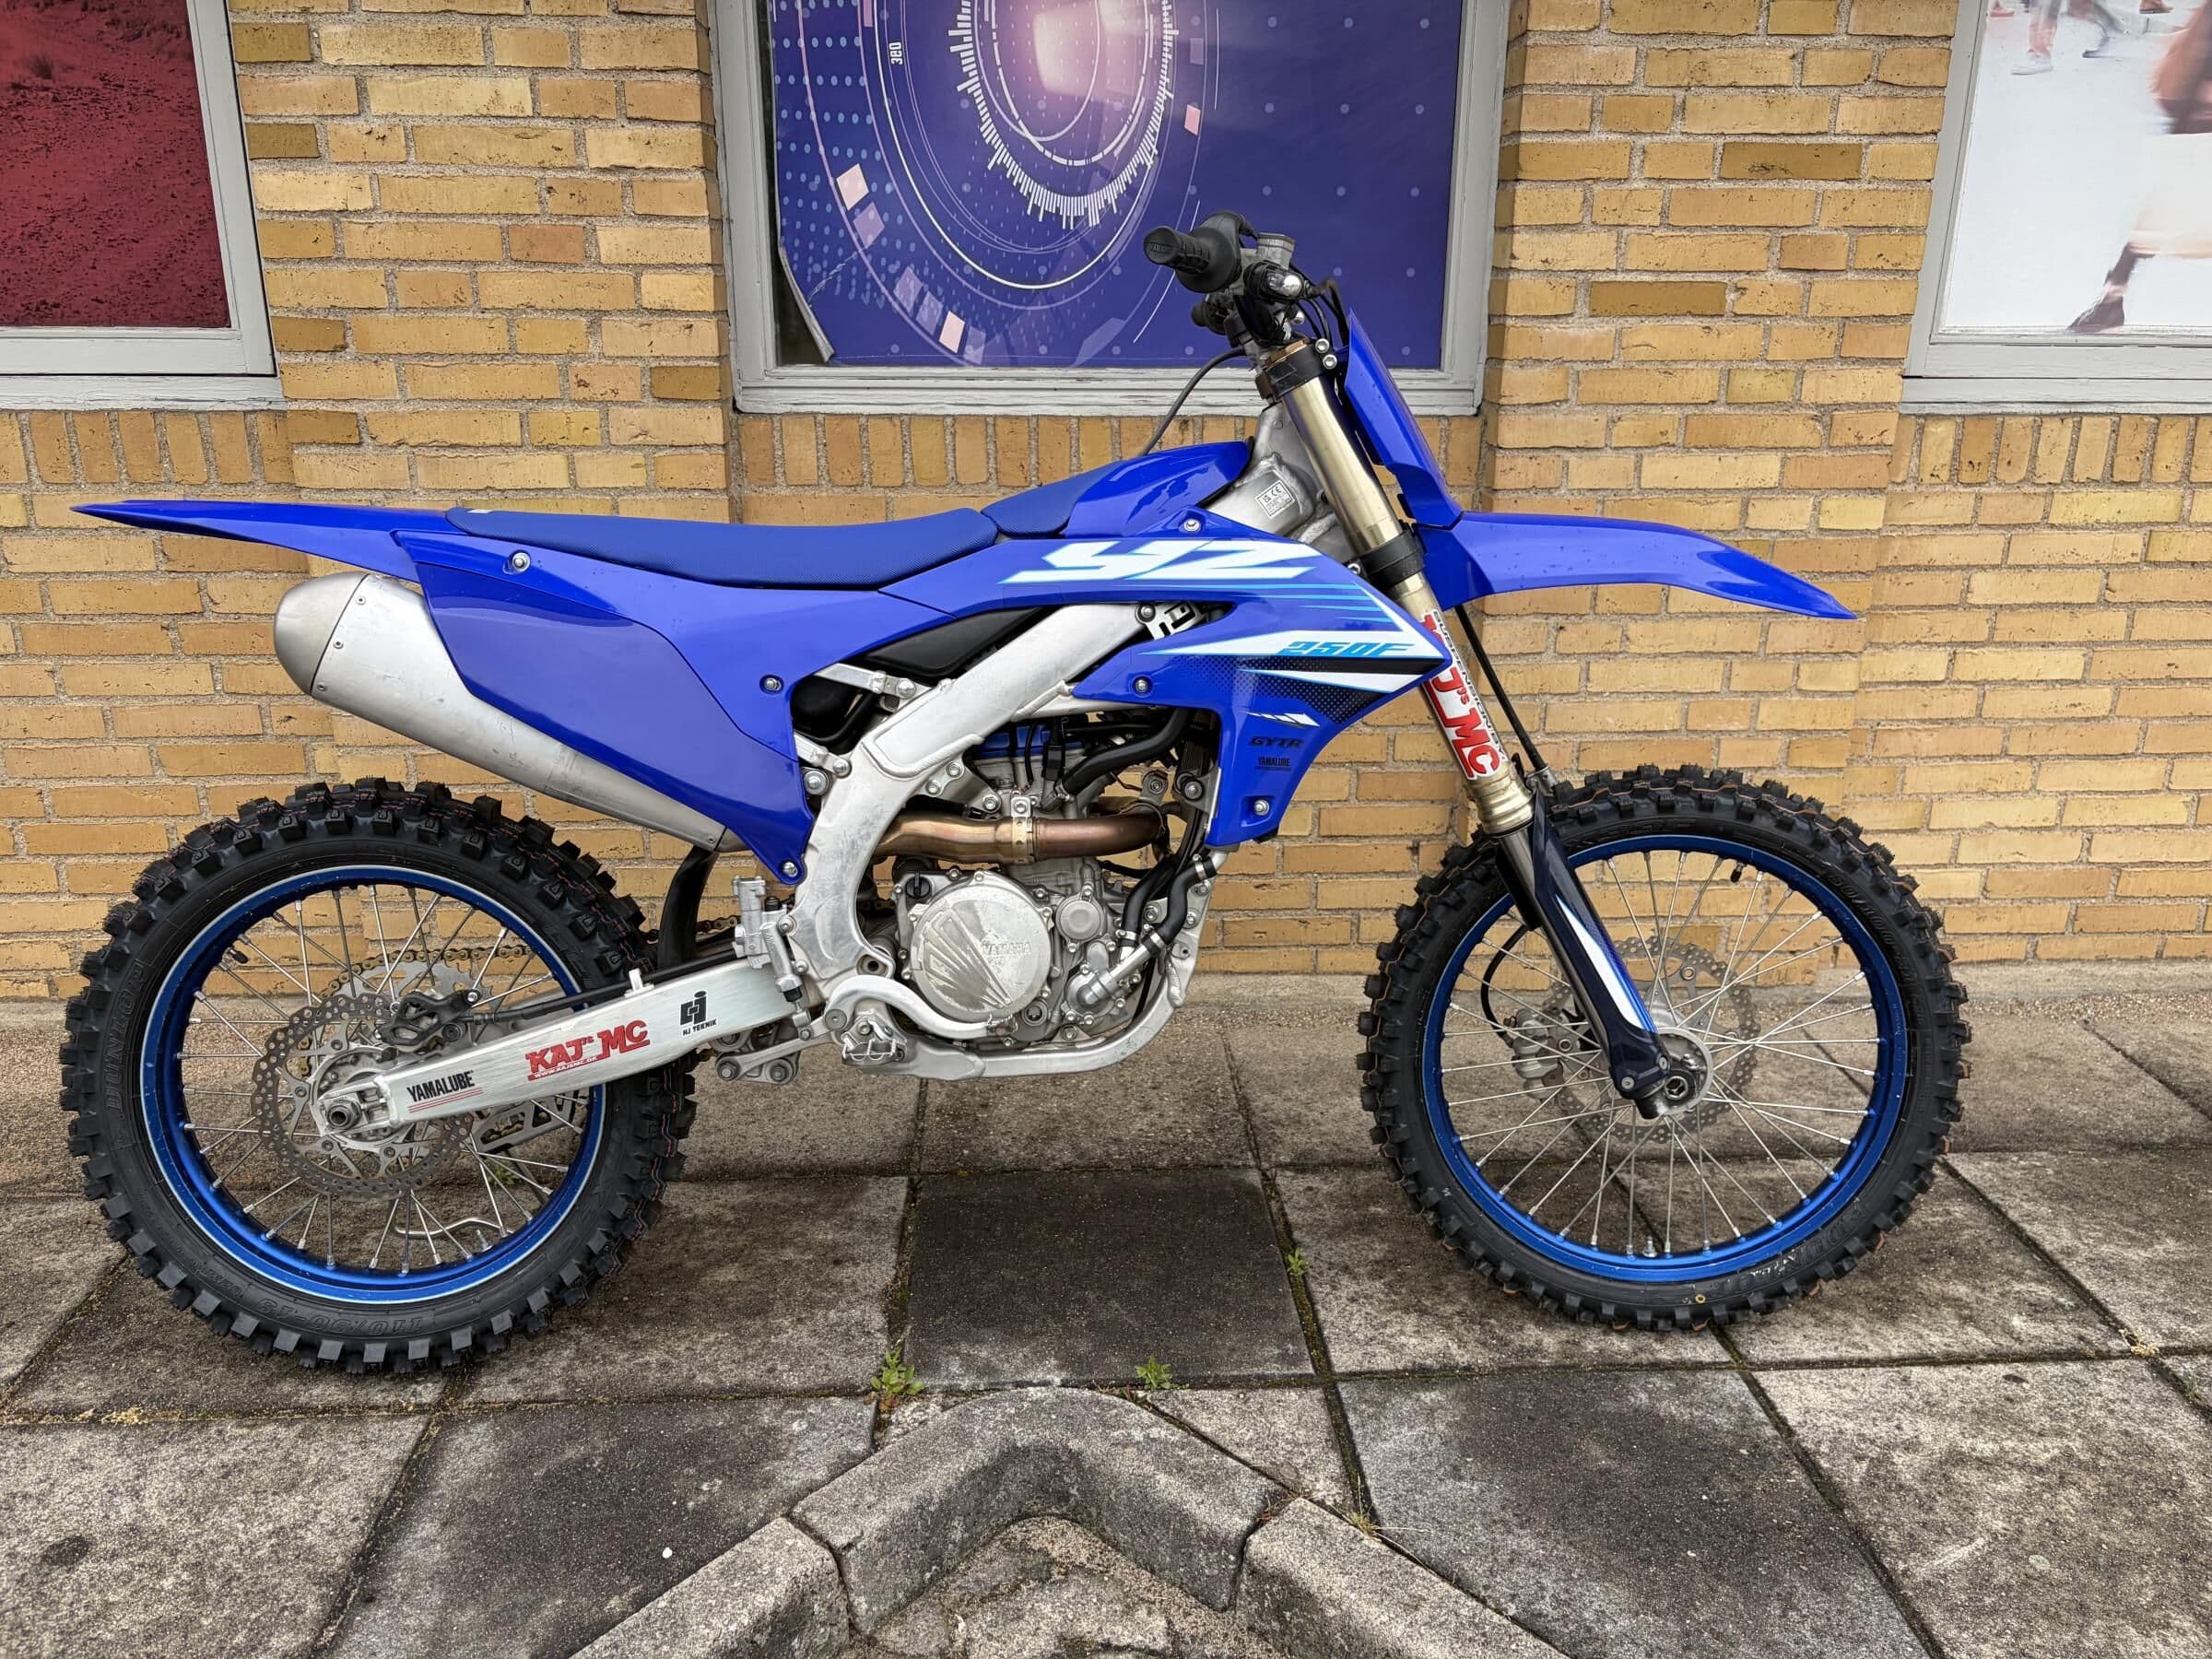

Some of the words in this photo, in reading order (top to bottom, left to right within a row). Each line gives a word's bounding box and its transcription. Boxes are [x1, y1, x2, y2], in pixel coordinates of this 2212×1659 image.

[996, 540, 1324, 584] YZ
[1277, 641, 1416, 657] 250F
[1432, 610, 1491, 729] SUSPENSION
[1250, 736, 1305, 748] GYTR
[1444, 707, 1500, 777] MC
[983, 941, 1032, 956] YAMAHA
[596, 1019, 650, 1057] MC
[406, 1071, 476, 1102] YAMALUBE
